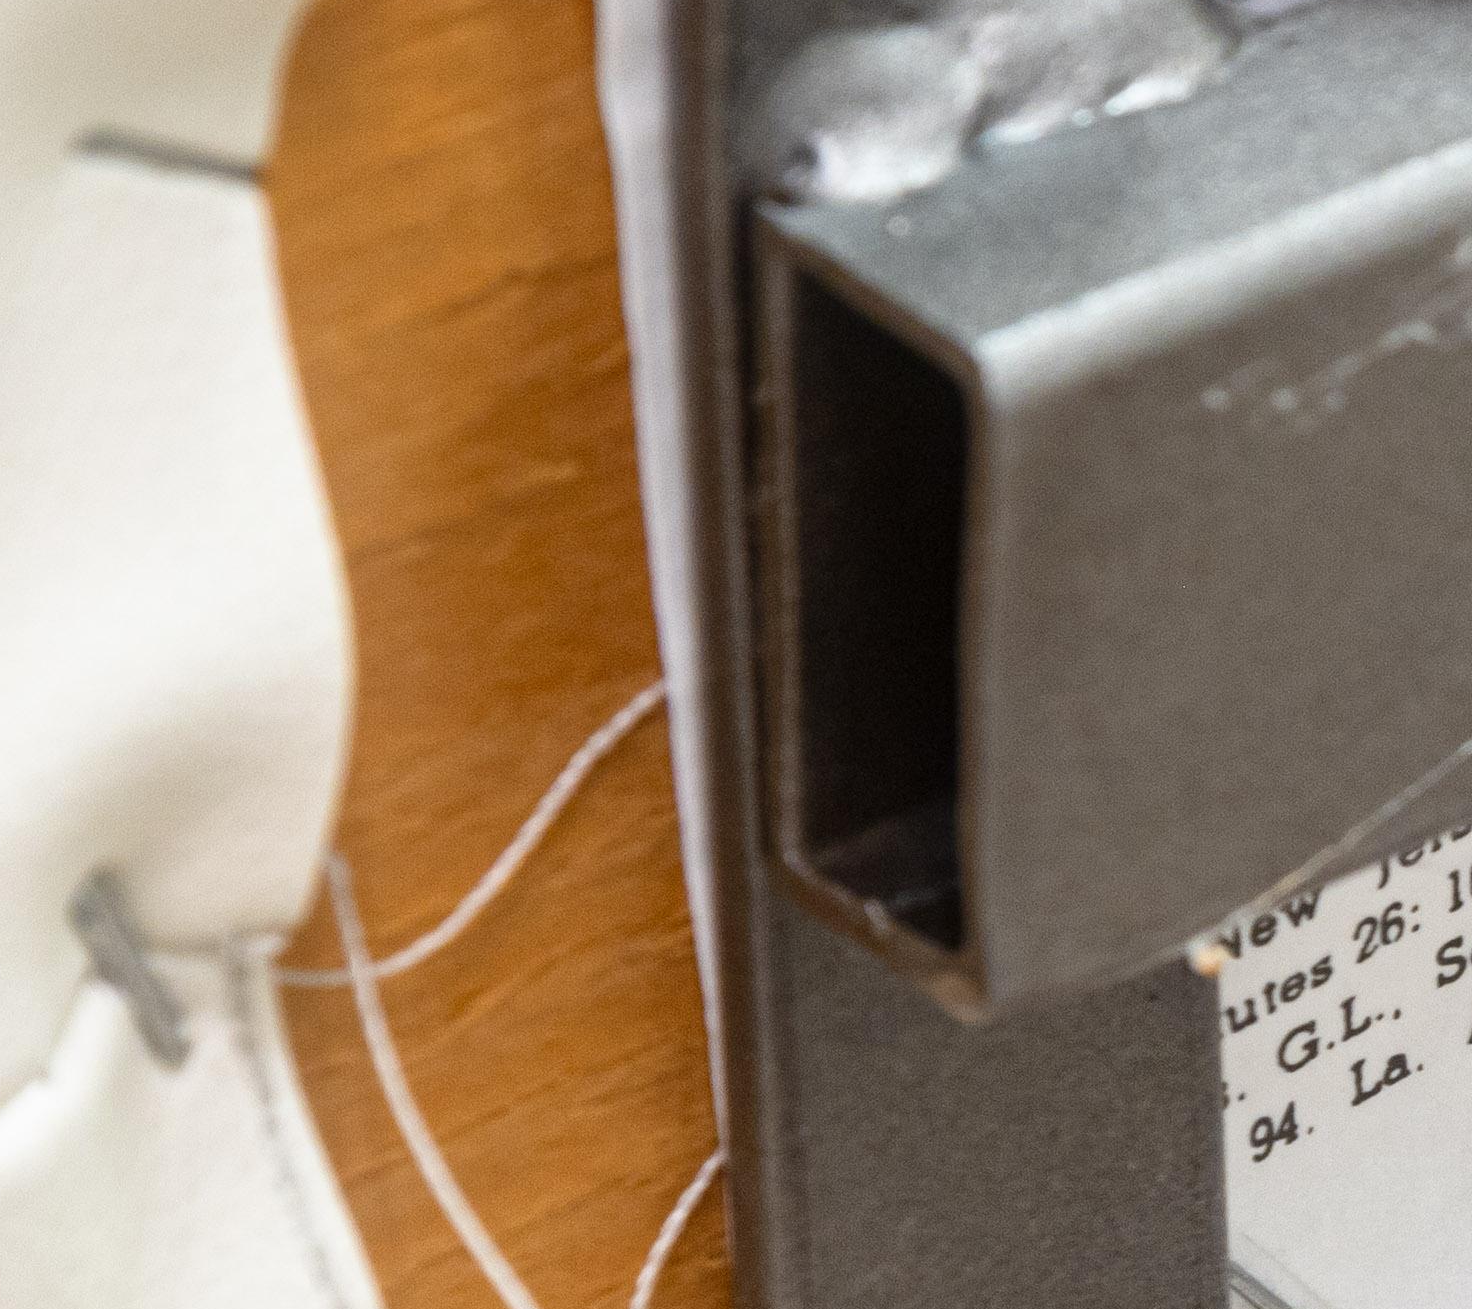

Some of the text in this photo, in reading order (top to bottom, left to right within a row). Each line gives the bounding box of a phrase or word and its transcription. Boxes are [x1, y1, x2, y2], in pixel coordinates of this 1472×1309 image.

[1353, 901, 1422, 964] 26:
[1250, 1101, 1315, 1163] 94.
[1350, 1053, 1425, 1106] La.
